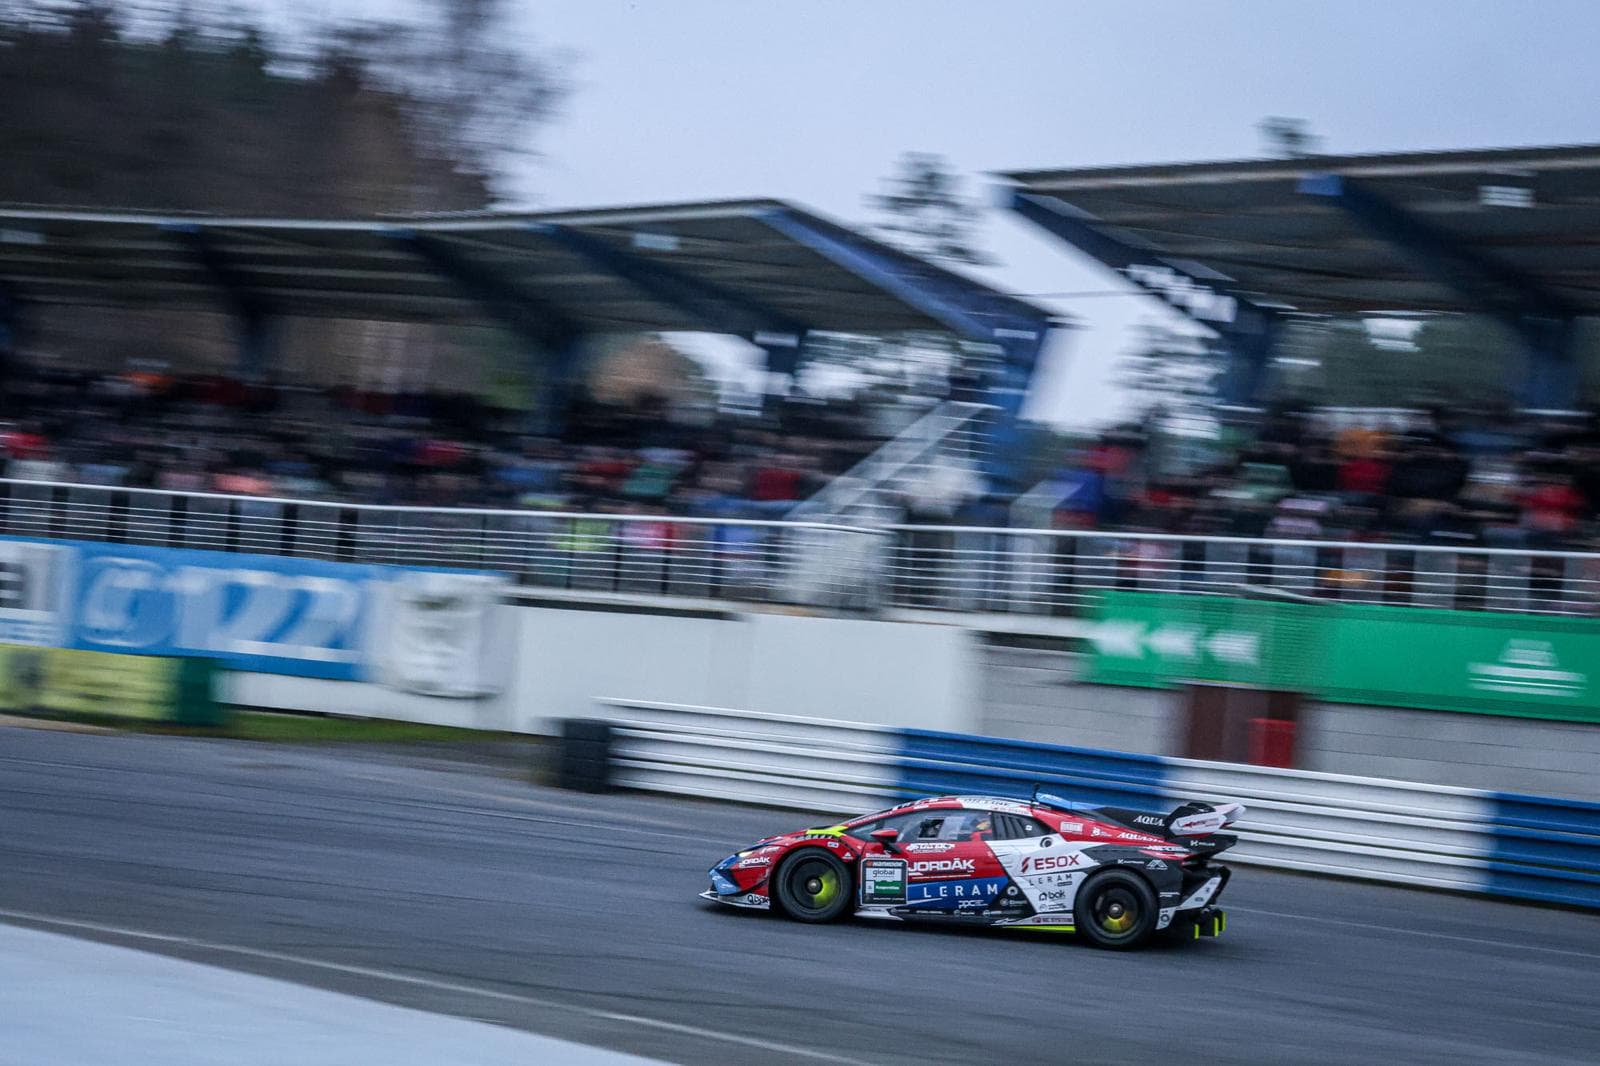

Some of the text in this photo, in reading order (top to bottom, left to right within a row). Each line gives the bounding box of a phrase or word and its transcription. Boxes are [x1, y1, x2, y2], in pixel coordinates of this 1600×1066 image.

[1034, 854, 1079, 870] ESOX
[1029, 873, 1073, 886] LERAM
[923, 884, 998, 898] LERAM
